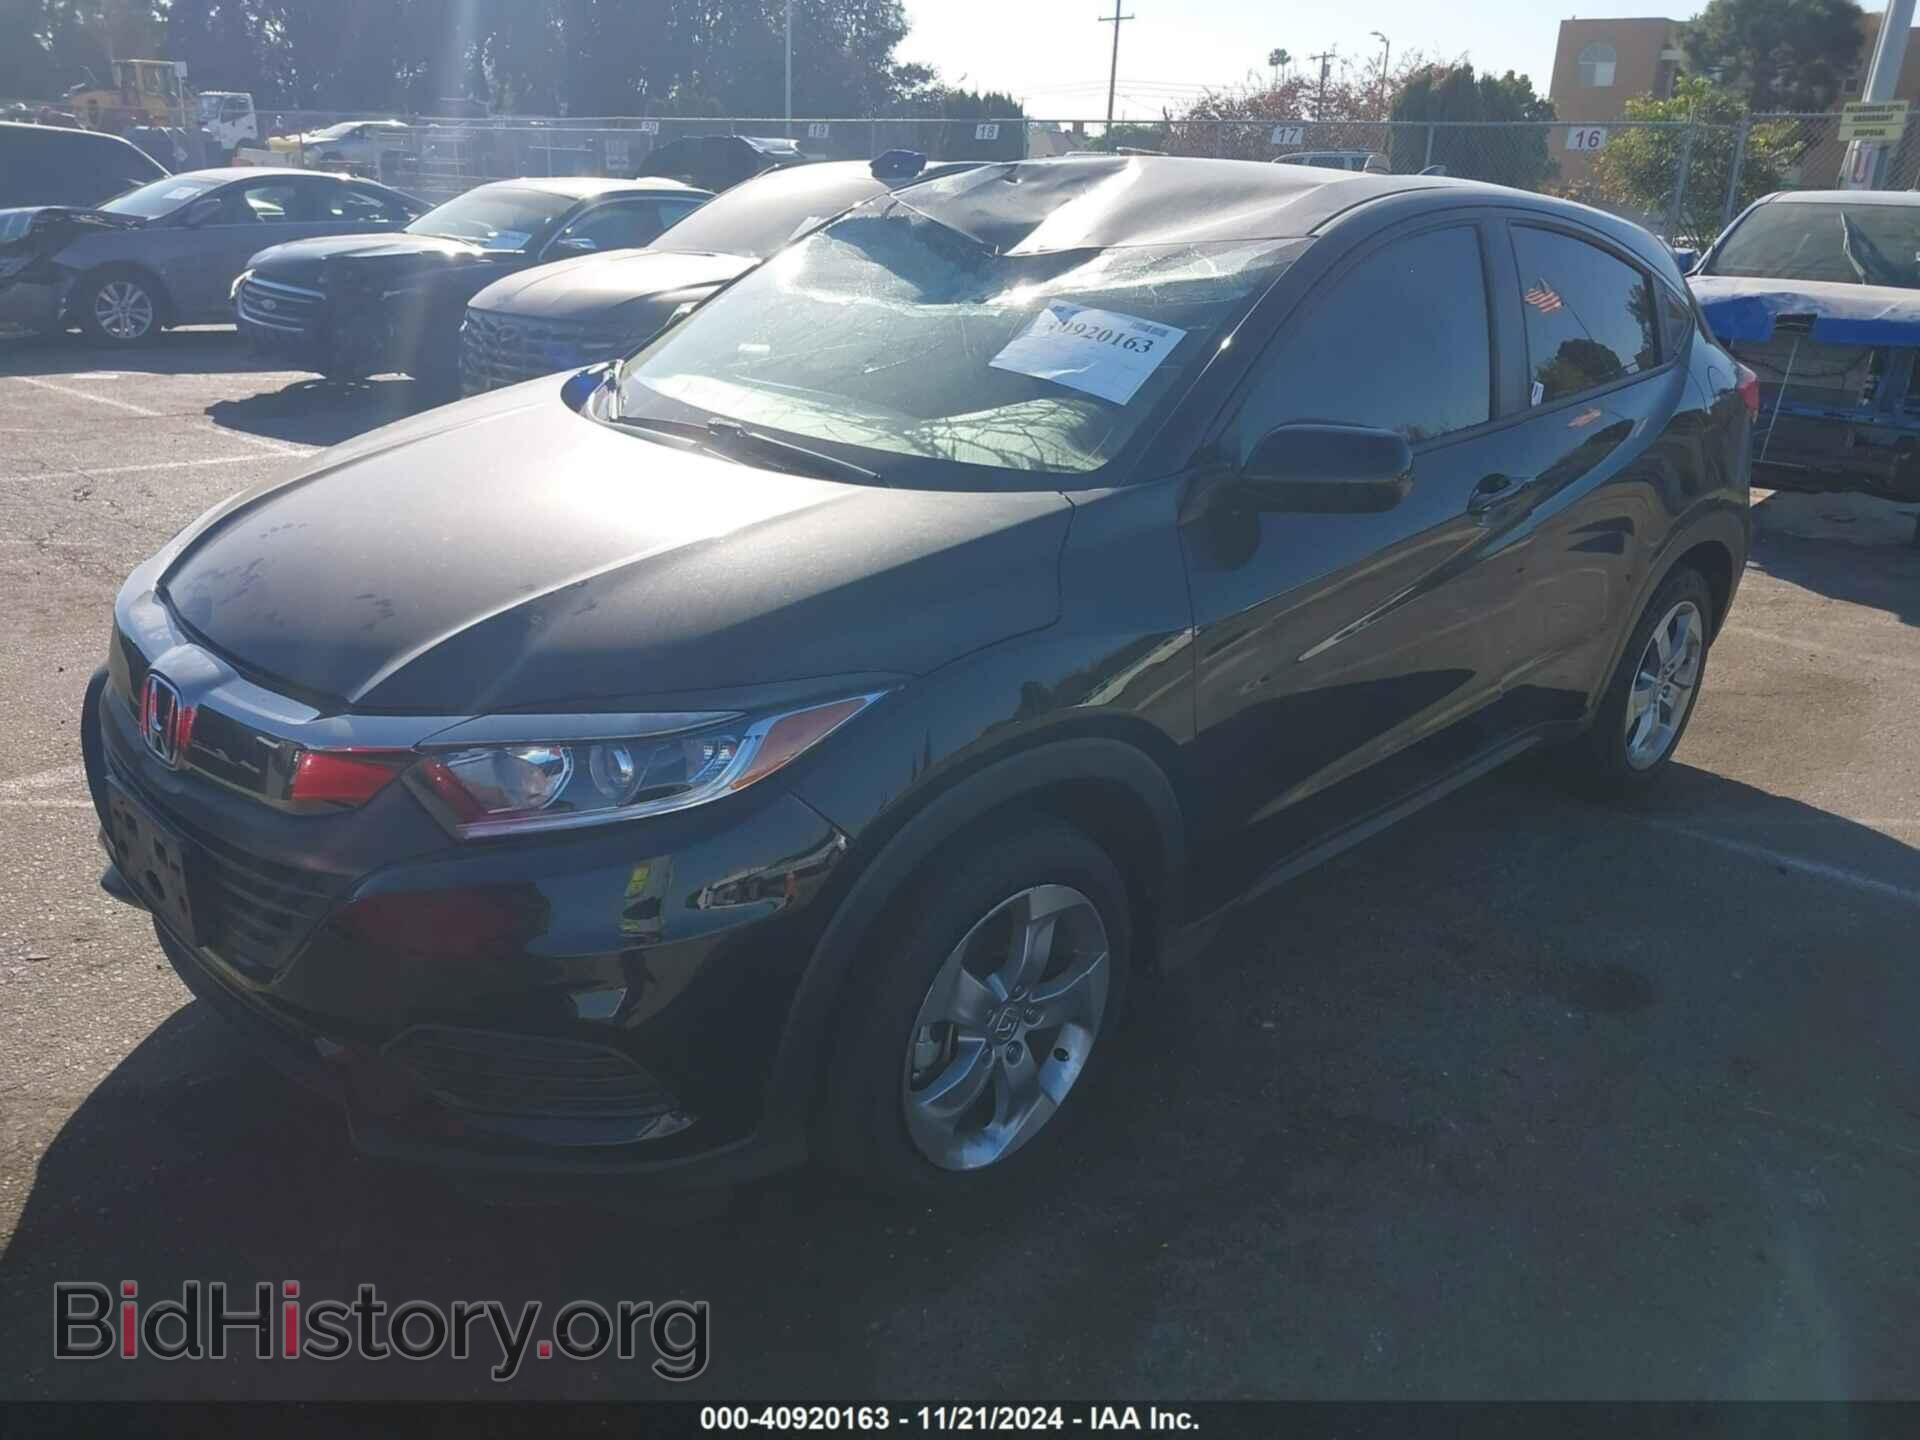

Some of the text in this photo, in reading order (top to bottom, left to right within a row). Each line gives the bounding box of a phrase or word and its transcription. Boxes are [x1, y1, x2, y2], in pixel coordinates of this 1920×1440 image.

[980, 125, 995, 138] 18
[1278, 127, 1298, 142] 17
[1575, 129, 1600, 148] 16
